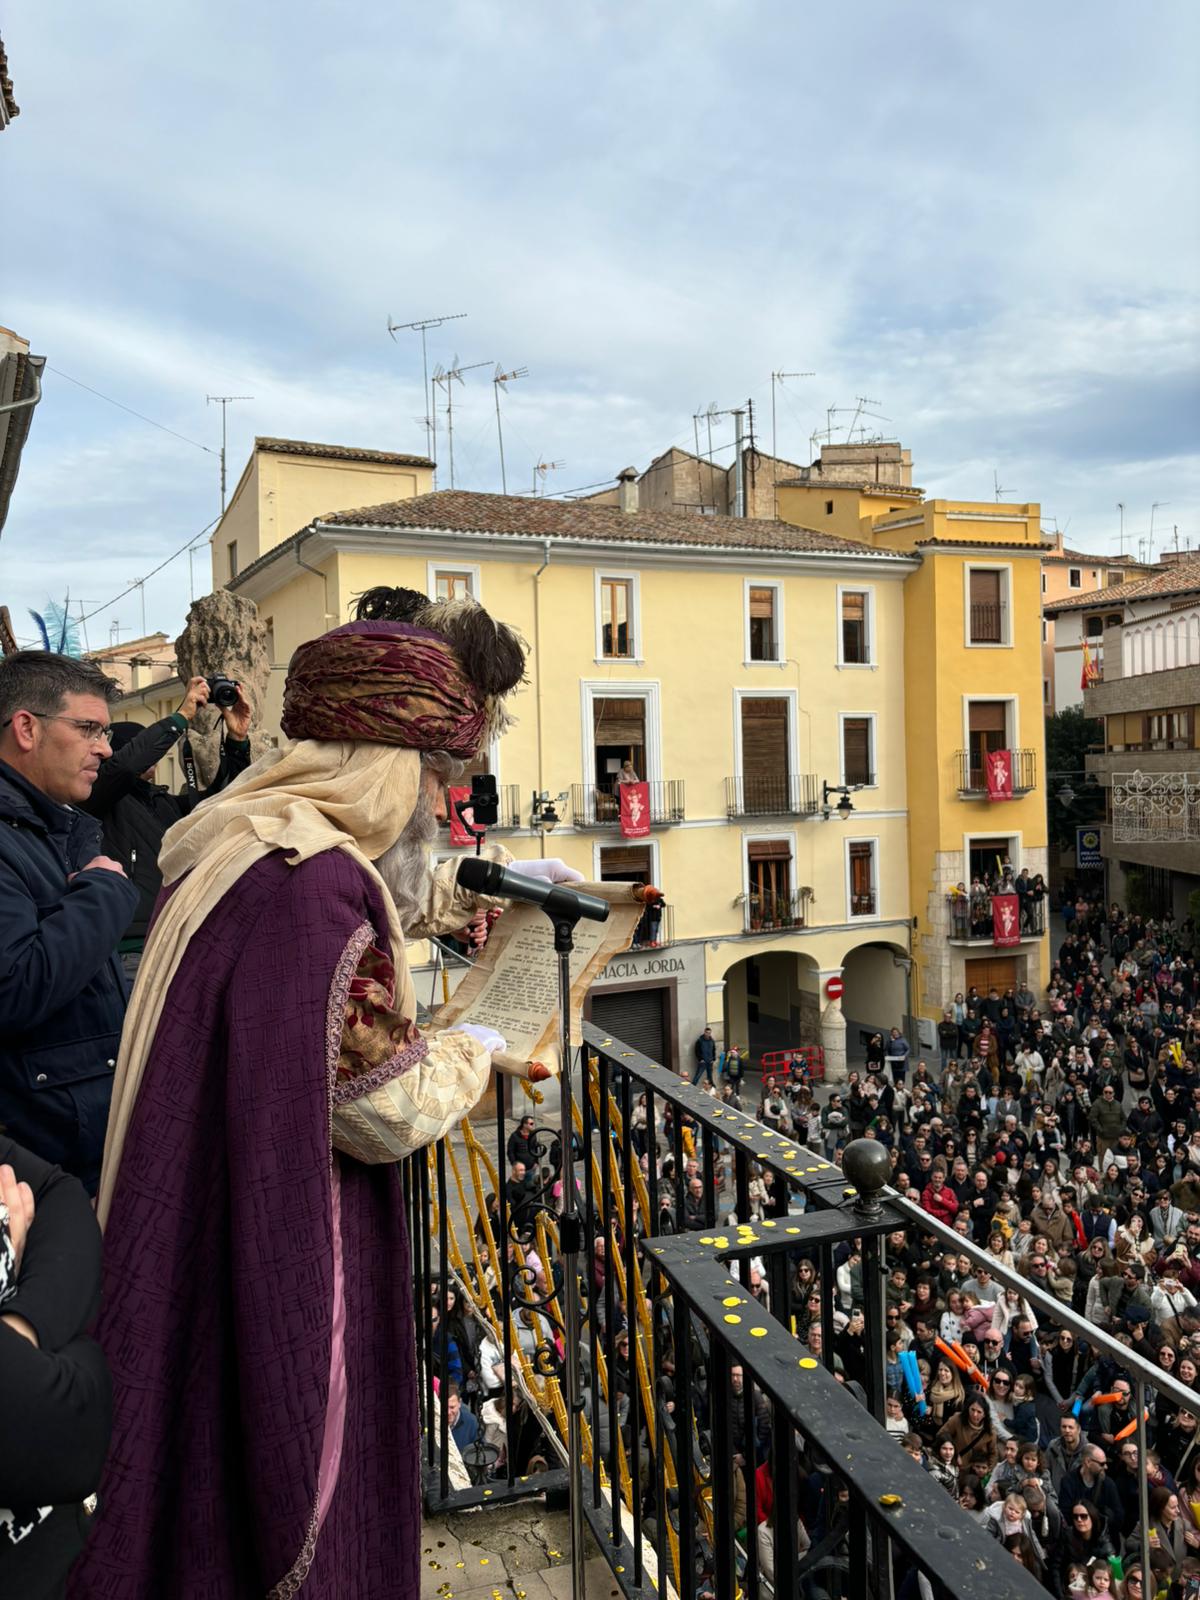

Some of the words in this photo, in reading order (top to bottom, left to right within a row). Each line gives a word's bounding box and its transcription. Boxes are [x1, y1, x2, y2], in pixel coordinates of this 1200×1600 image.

[186, 762, 196, 789] SONY
[594, 963, 639, 980] MACIA
[643, 958, 685, 975] JORDA
